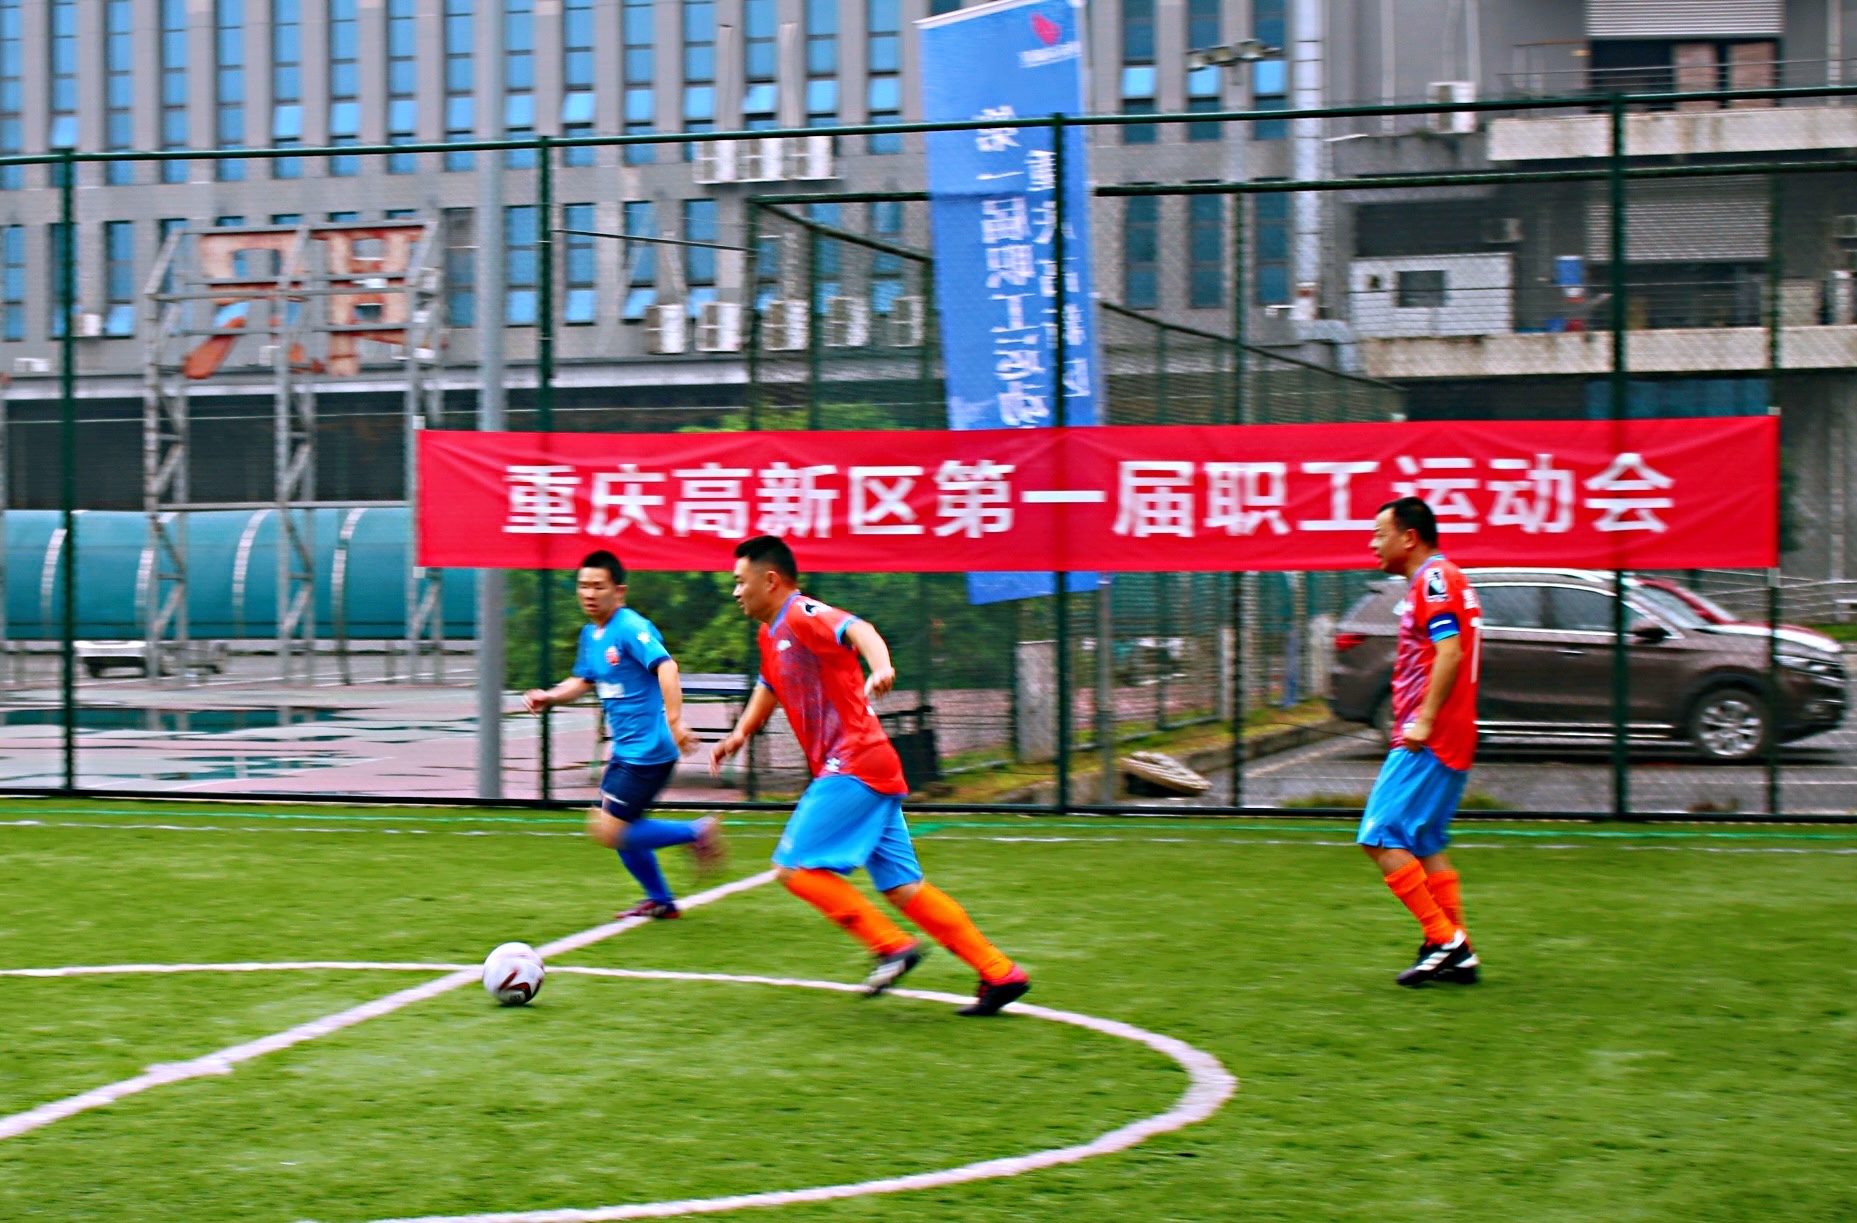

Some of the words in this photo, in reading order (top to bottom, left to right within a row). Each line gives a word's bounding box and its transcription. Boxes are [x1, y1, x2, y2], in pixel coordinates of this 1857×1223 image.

[503, 453, 1673, 538] 重庆高新区第一届职工运动会
